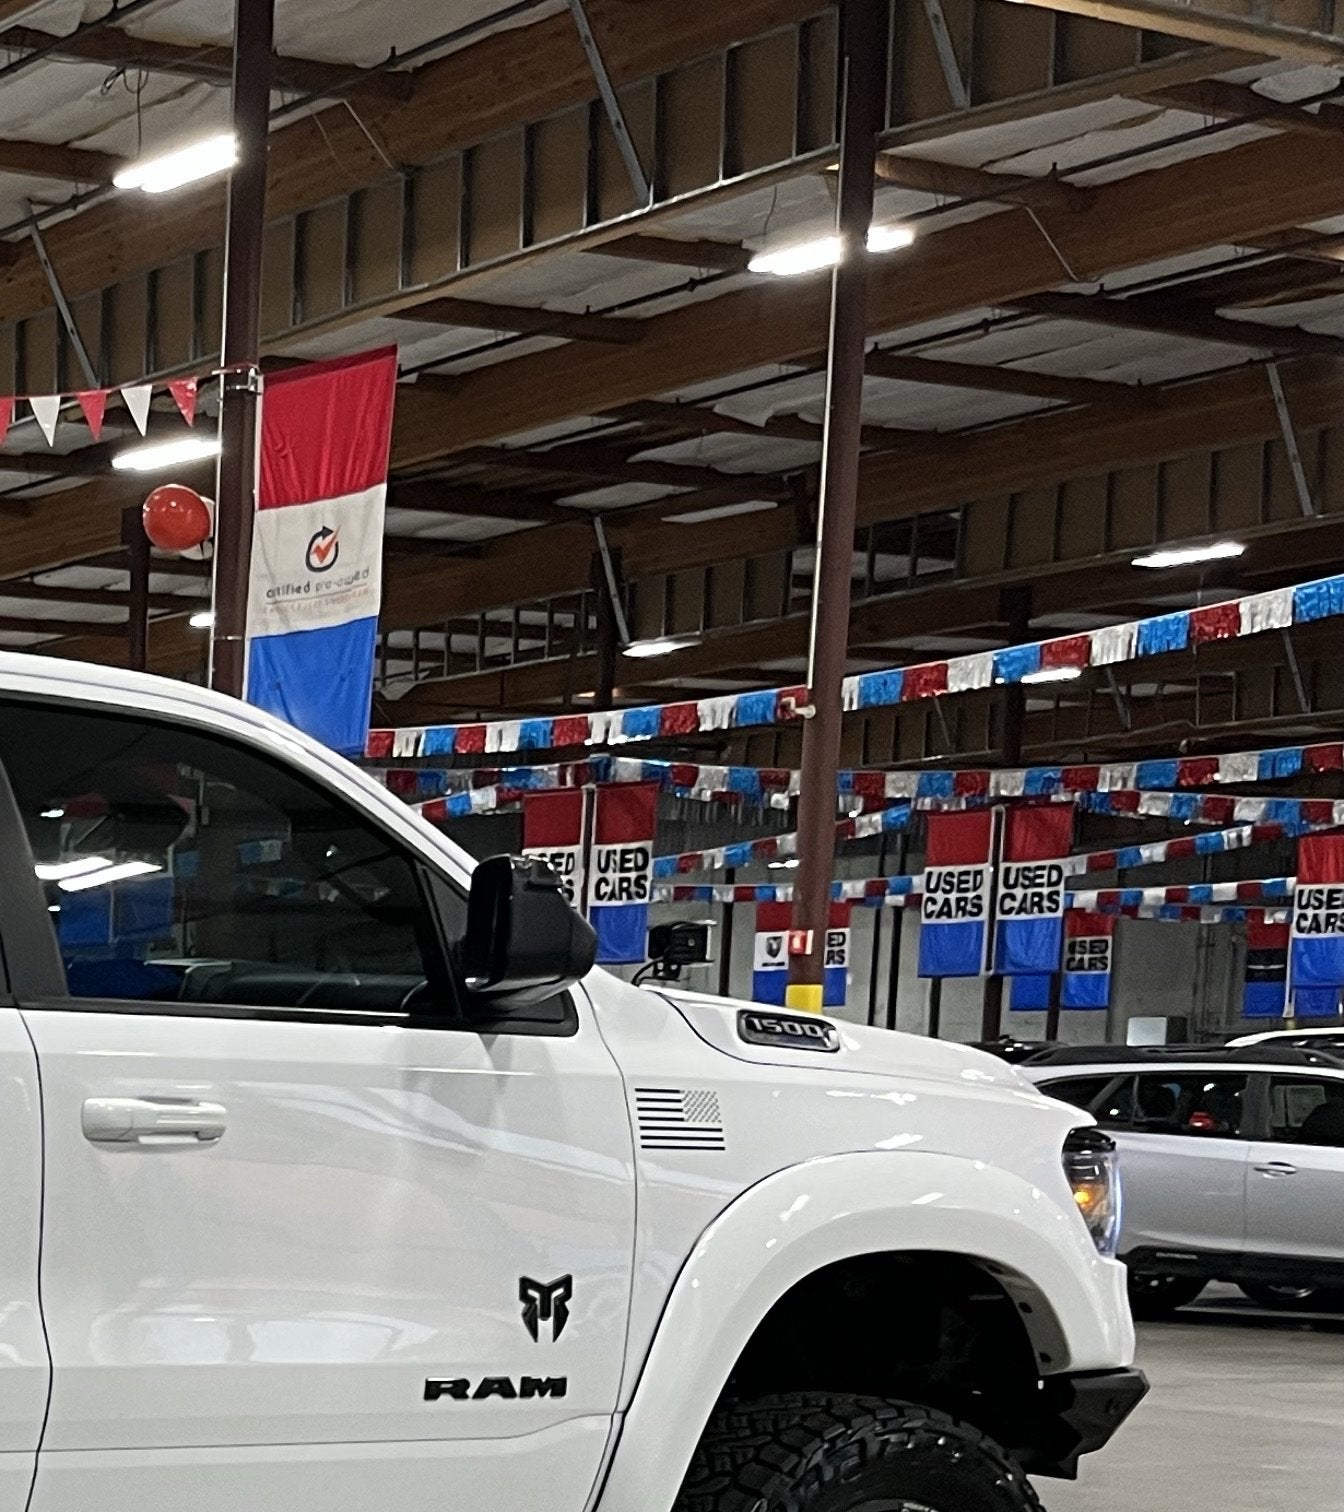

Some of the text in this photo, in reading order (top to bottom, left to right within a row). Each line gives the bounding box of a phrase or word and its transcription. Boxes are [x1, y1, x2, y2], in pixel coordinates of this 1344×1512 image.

[538, 852, 575, 876] ED
[594, 875, 648, 901] CARS
[925, 869, 984, 895] USED
[1003, 864, 1063, 890] USED
[923, 894, 983, 919] CARS
[999, 890, 1061, 915] CARS
[1297, 888, 1344, 910] USE
[827, 931, 846, 947] ED
[1068, 939, 1109, 955] USED
[825, 949, 846, 965] RS
[751, 1017, 825, 1038] 1500
[423, 1376, 567, 1401] RAM
